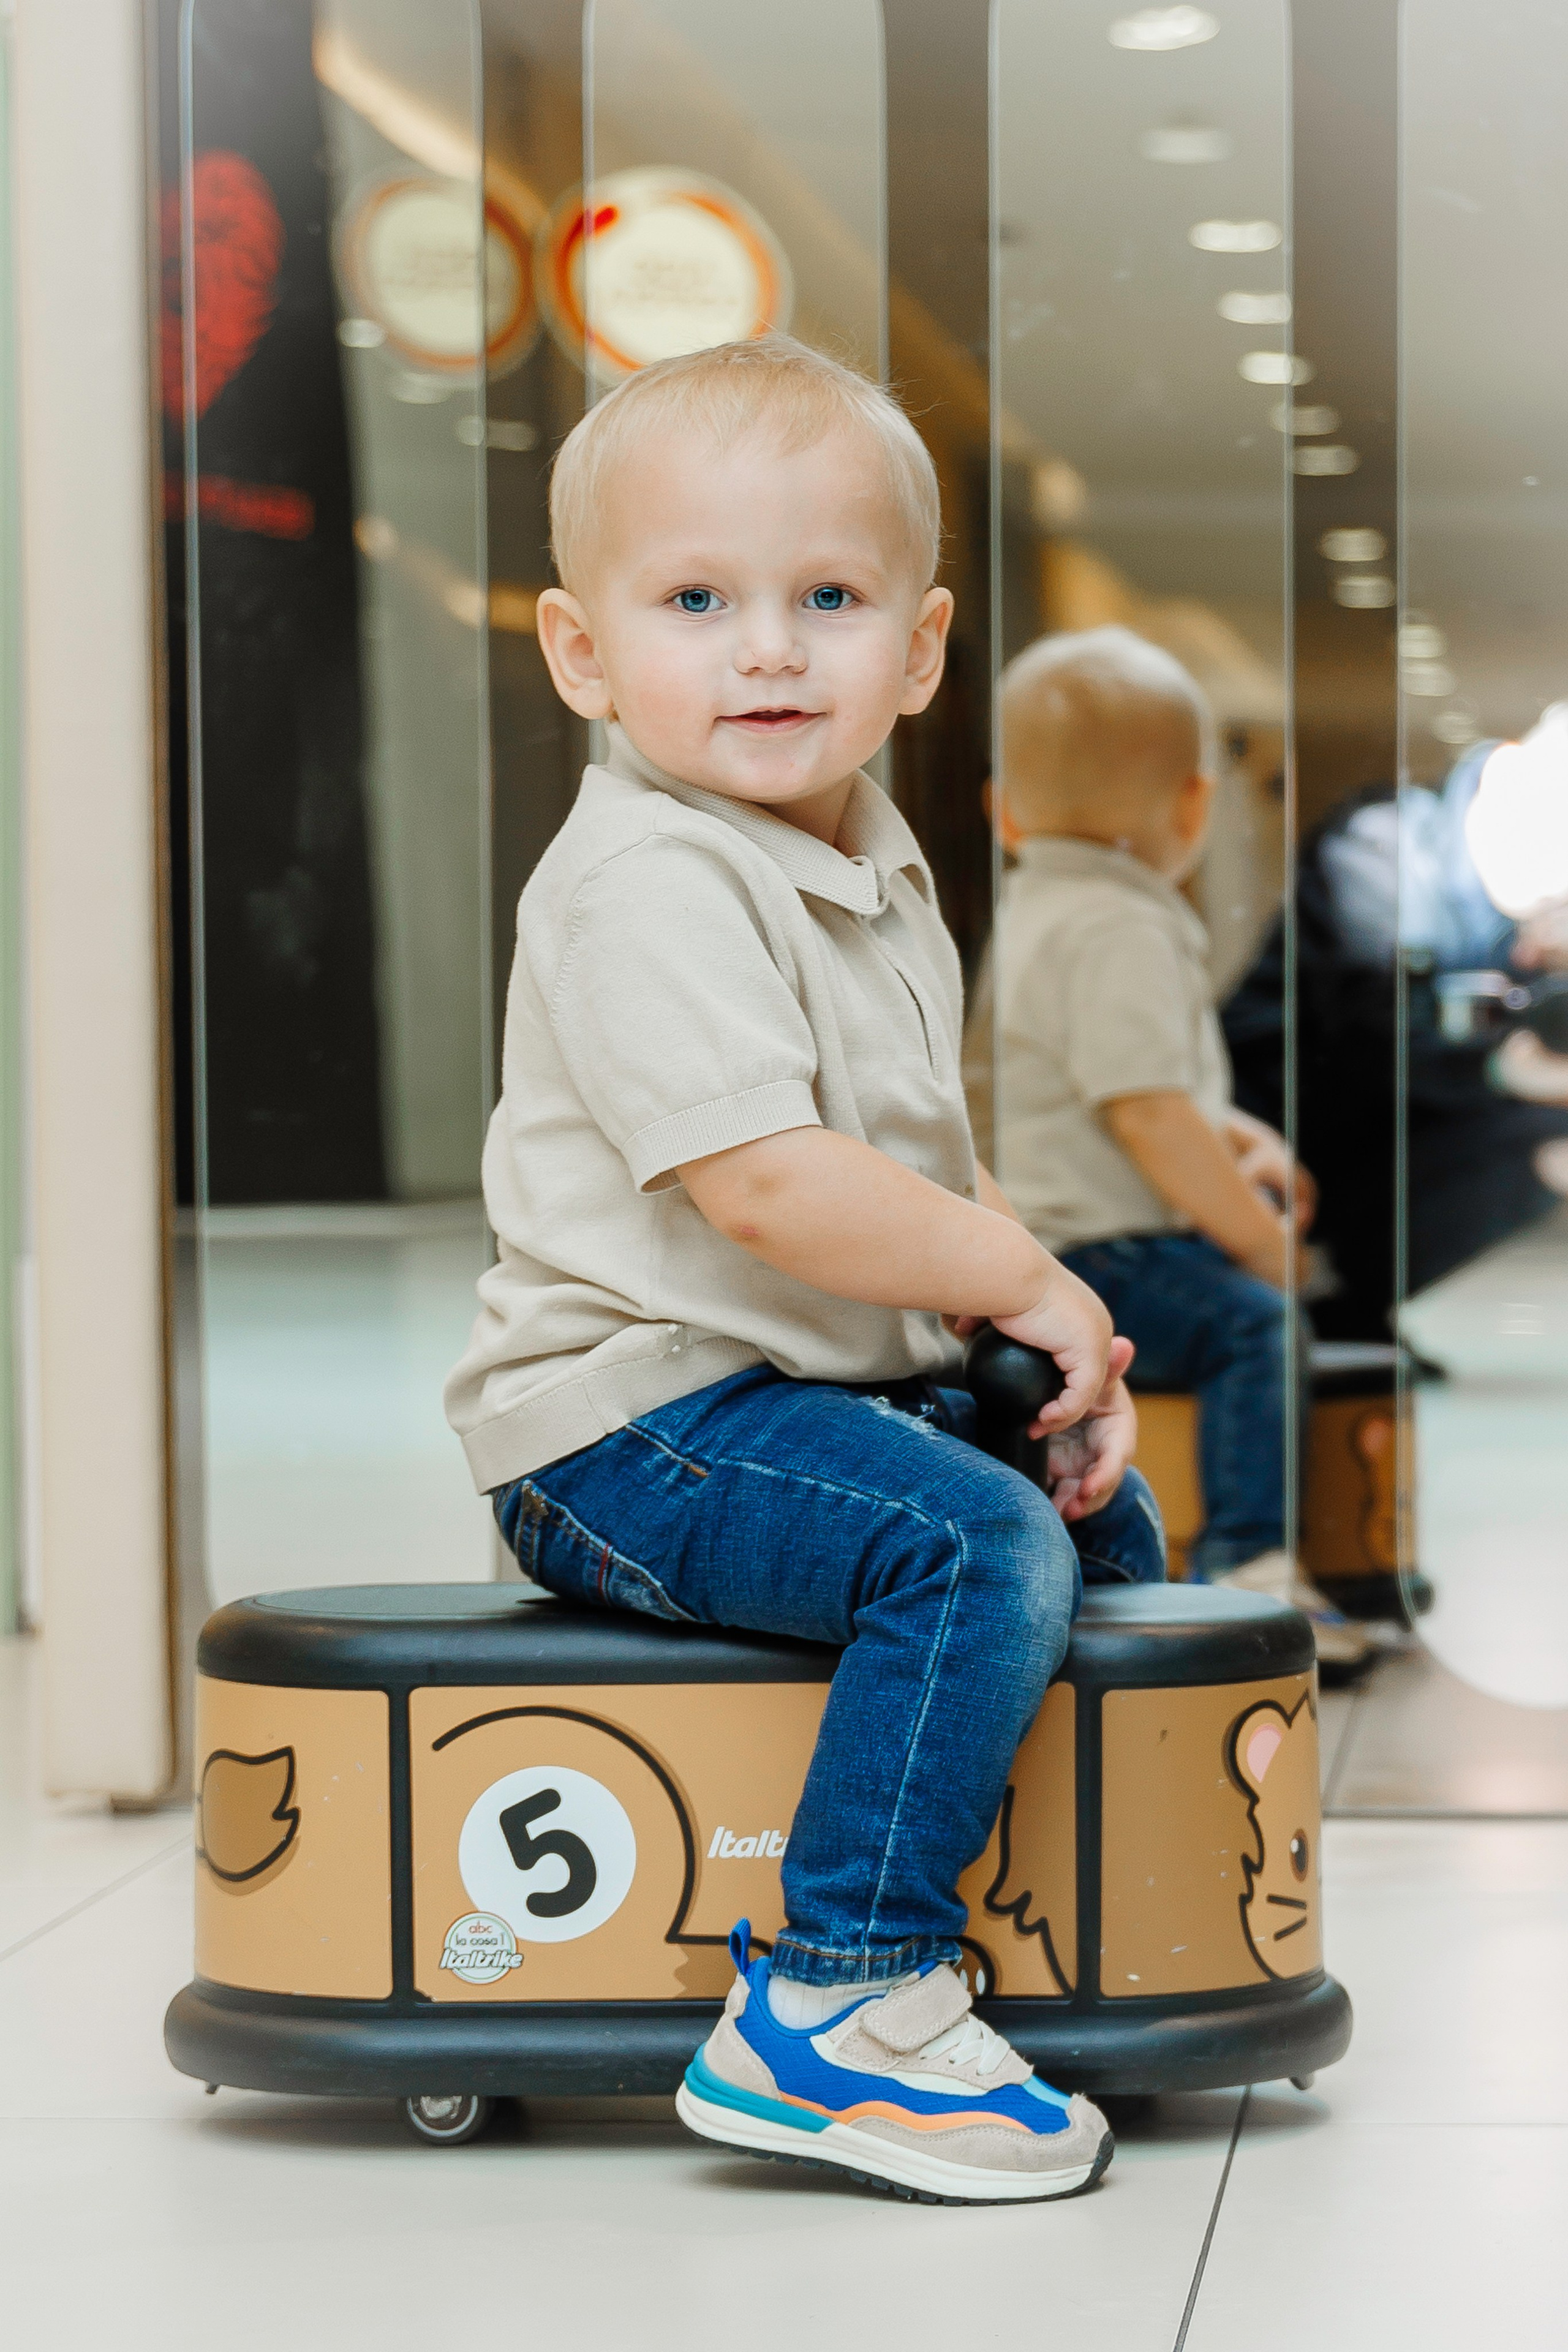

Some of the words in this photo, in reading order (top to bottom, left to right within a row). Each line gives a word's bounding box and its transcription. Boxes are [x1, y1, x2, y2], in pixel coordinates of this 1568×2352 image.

[499, 1788, 597, 1918] 5
[469, 1920, 492, 1934] abc
[456, 1933, 467, 1945] la
[439, 1947, 524, 1969] Italtrike
